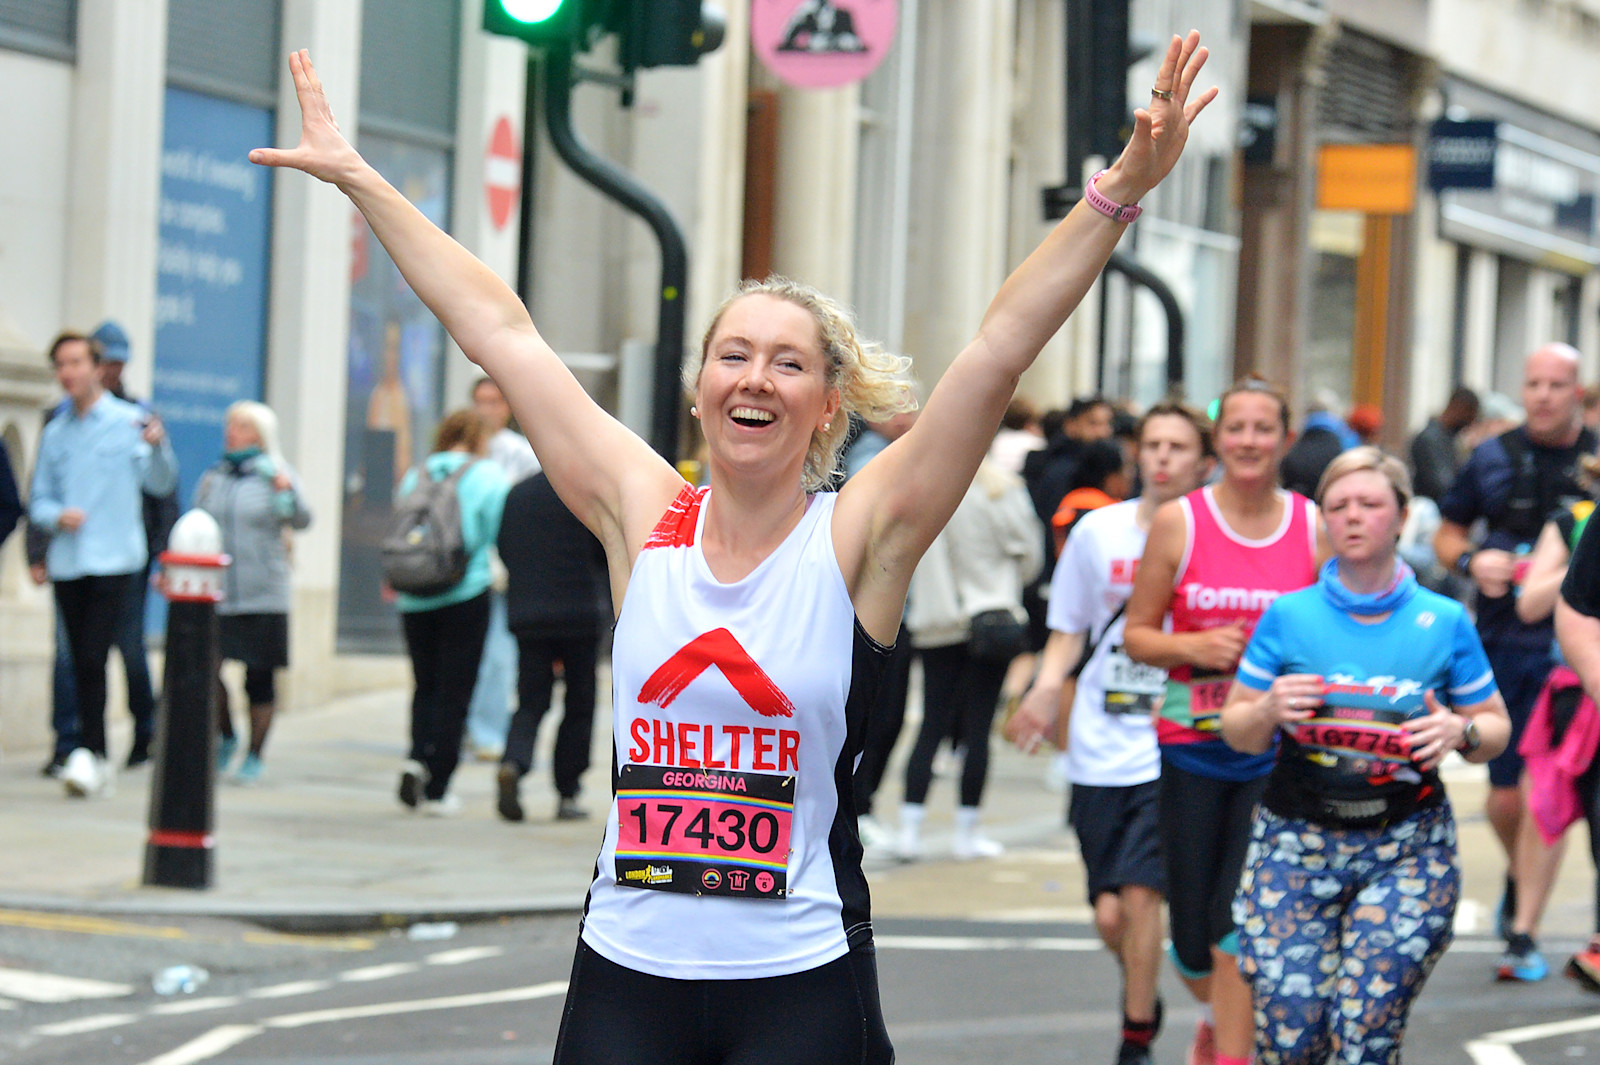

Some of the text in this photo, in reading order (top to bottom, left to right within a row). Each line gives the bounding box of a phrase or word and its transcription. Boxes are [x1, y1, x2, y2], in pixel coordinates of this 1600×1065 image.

[1185, 583, 1280, 611] Tomm
[629, 717, 800, 772] SHELTER
[662, 771, 747, 792] GEORGINA
[630, 803, 779, 853] 17430
